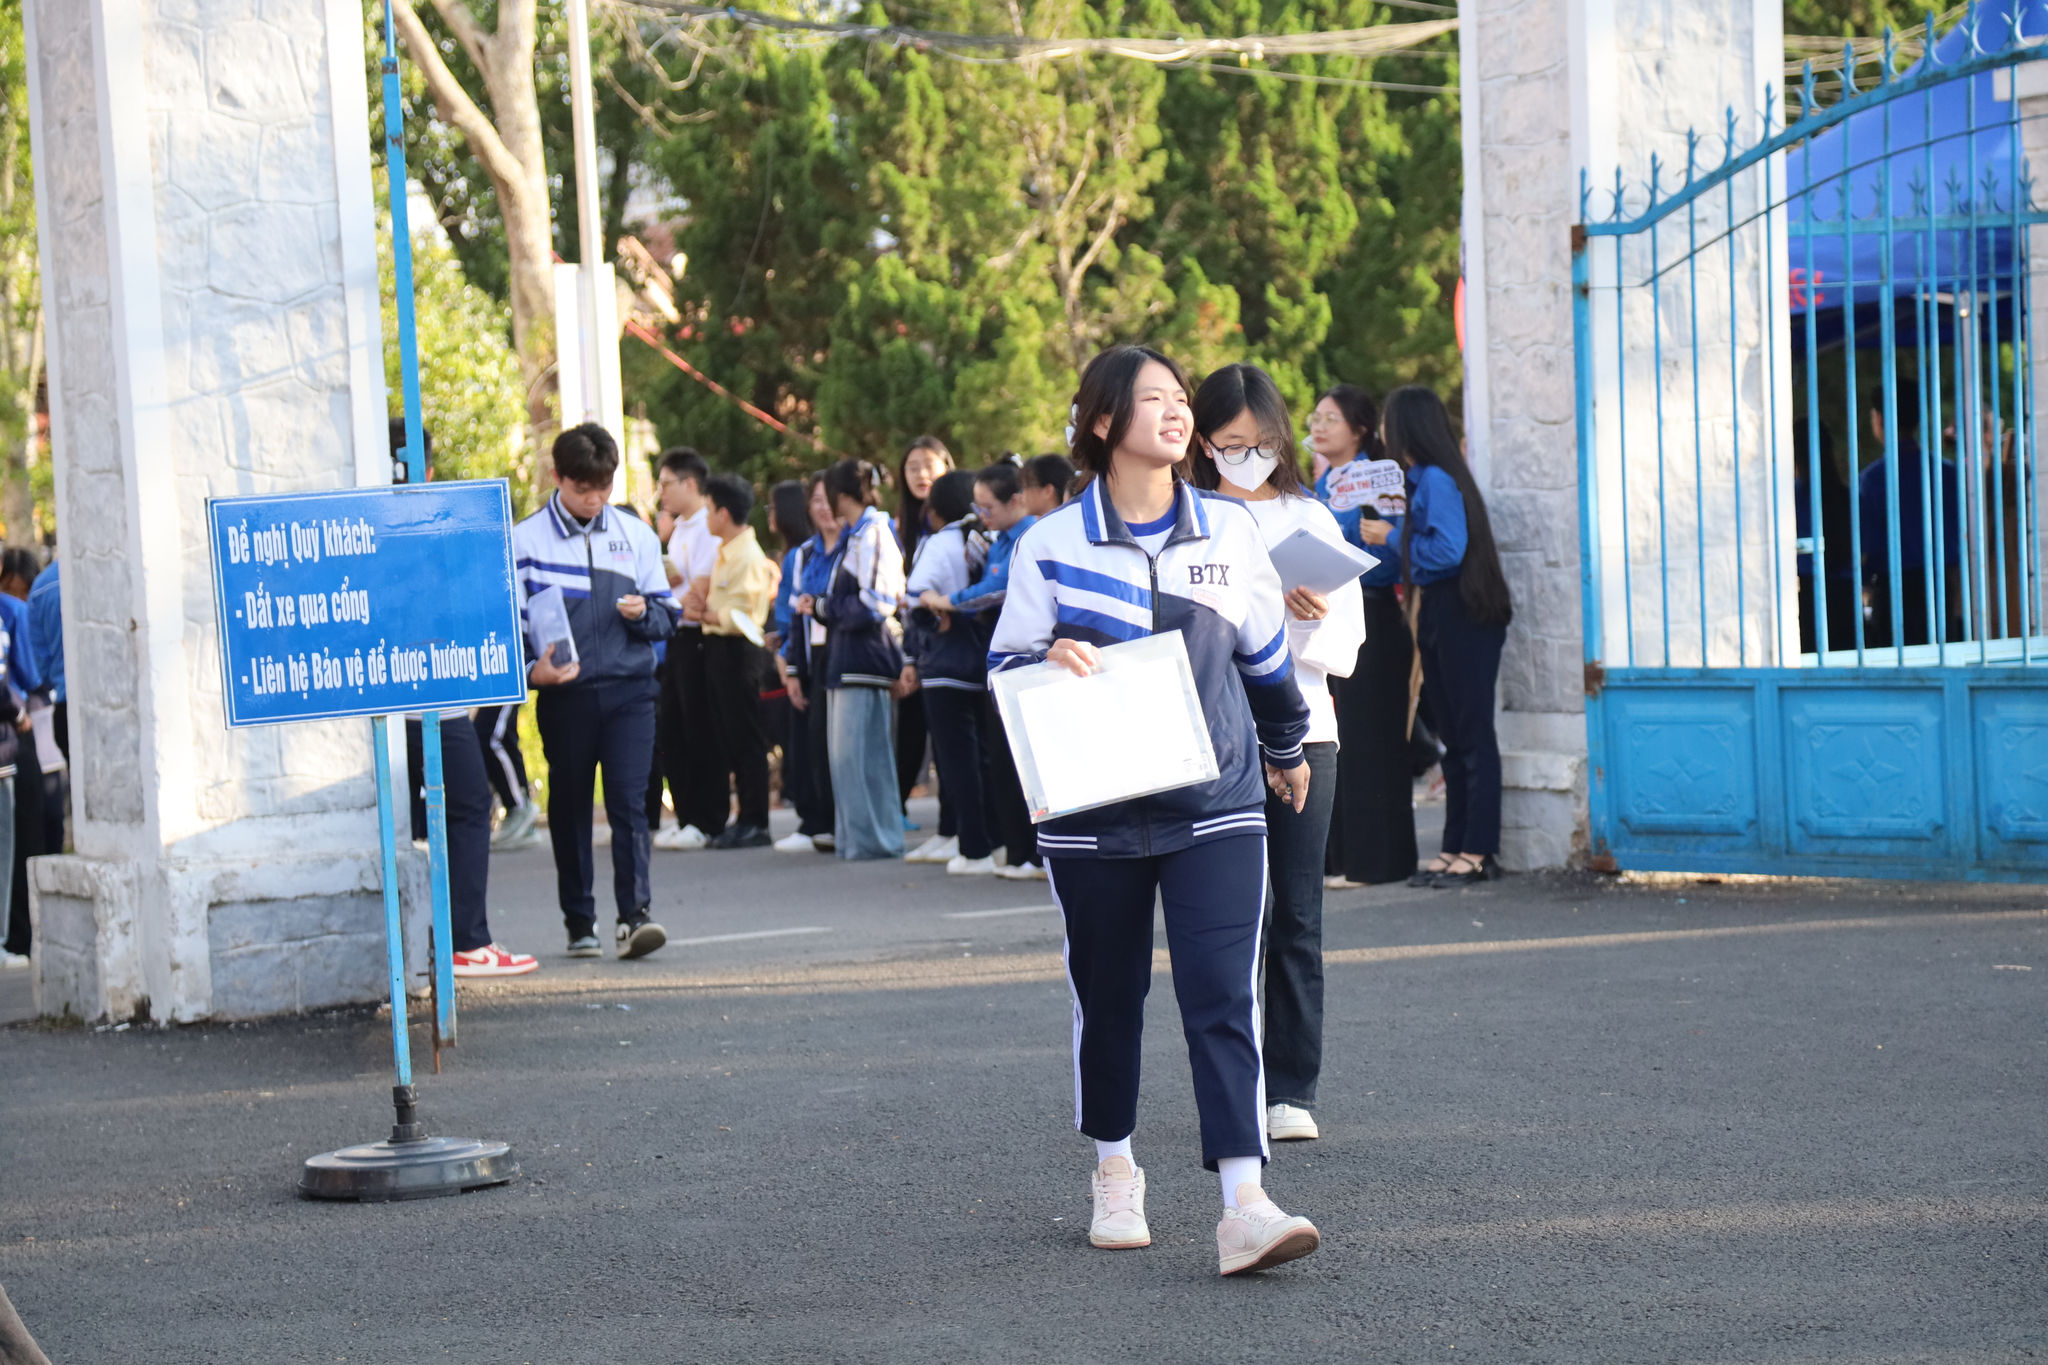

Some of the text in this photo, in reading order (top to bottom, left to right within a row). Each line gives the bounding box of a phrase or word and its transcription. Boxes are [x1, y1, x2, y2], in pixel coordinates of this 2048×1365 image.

[227, 517, 376, 568] Đề nghị Quý khách:
[1188, 563, 1230, 587] BTX
[245, 581, 274, 629] Dắt
[275, 595, 296, 627] xe
[298, 592, 329, 630] qua
[331, 575, 370, 625] cổng
[251, 655, 287, 696] Liên
[288, 652, 309, 700] hệ
[311, 646, 342, 690] Bảo
[344, 648, 364, 695] vệ
[367, 638, 387, 686] để
[390, 645, 428, 690] được
[430, 640, 478, 682] hướng
[480, 631, 509, 676] dẫn
